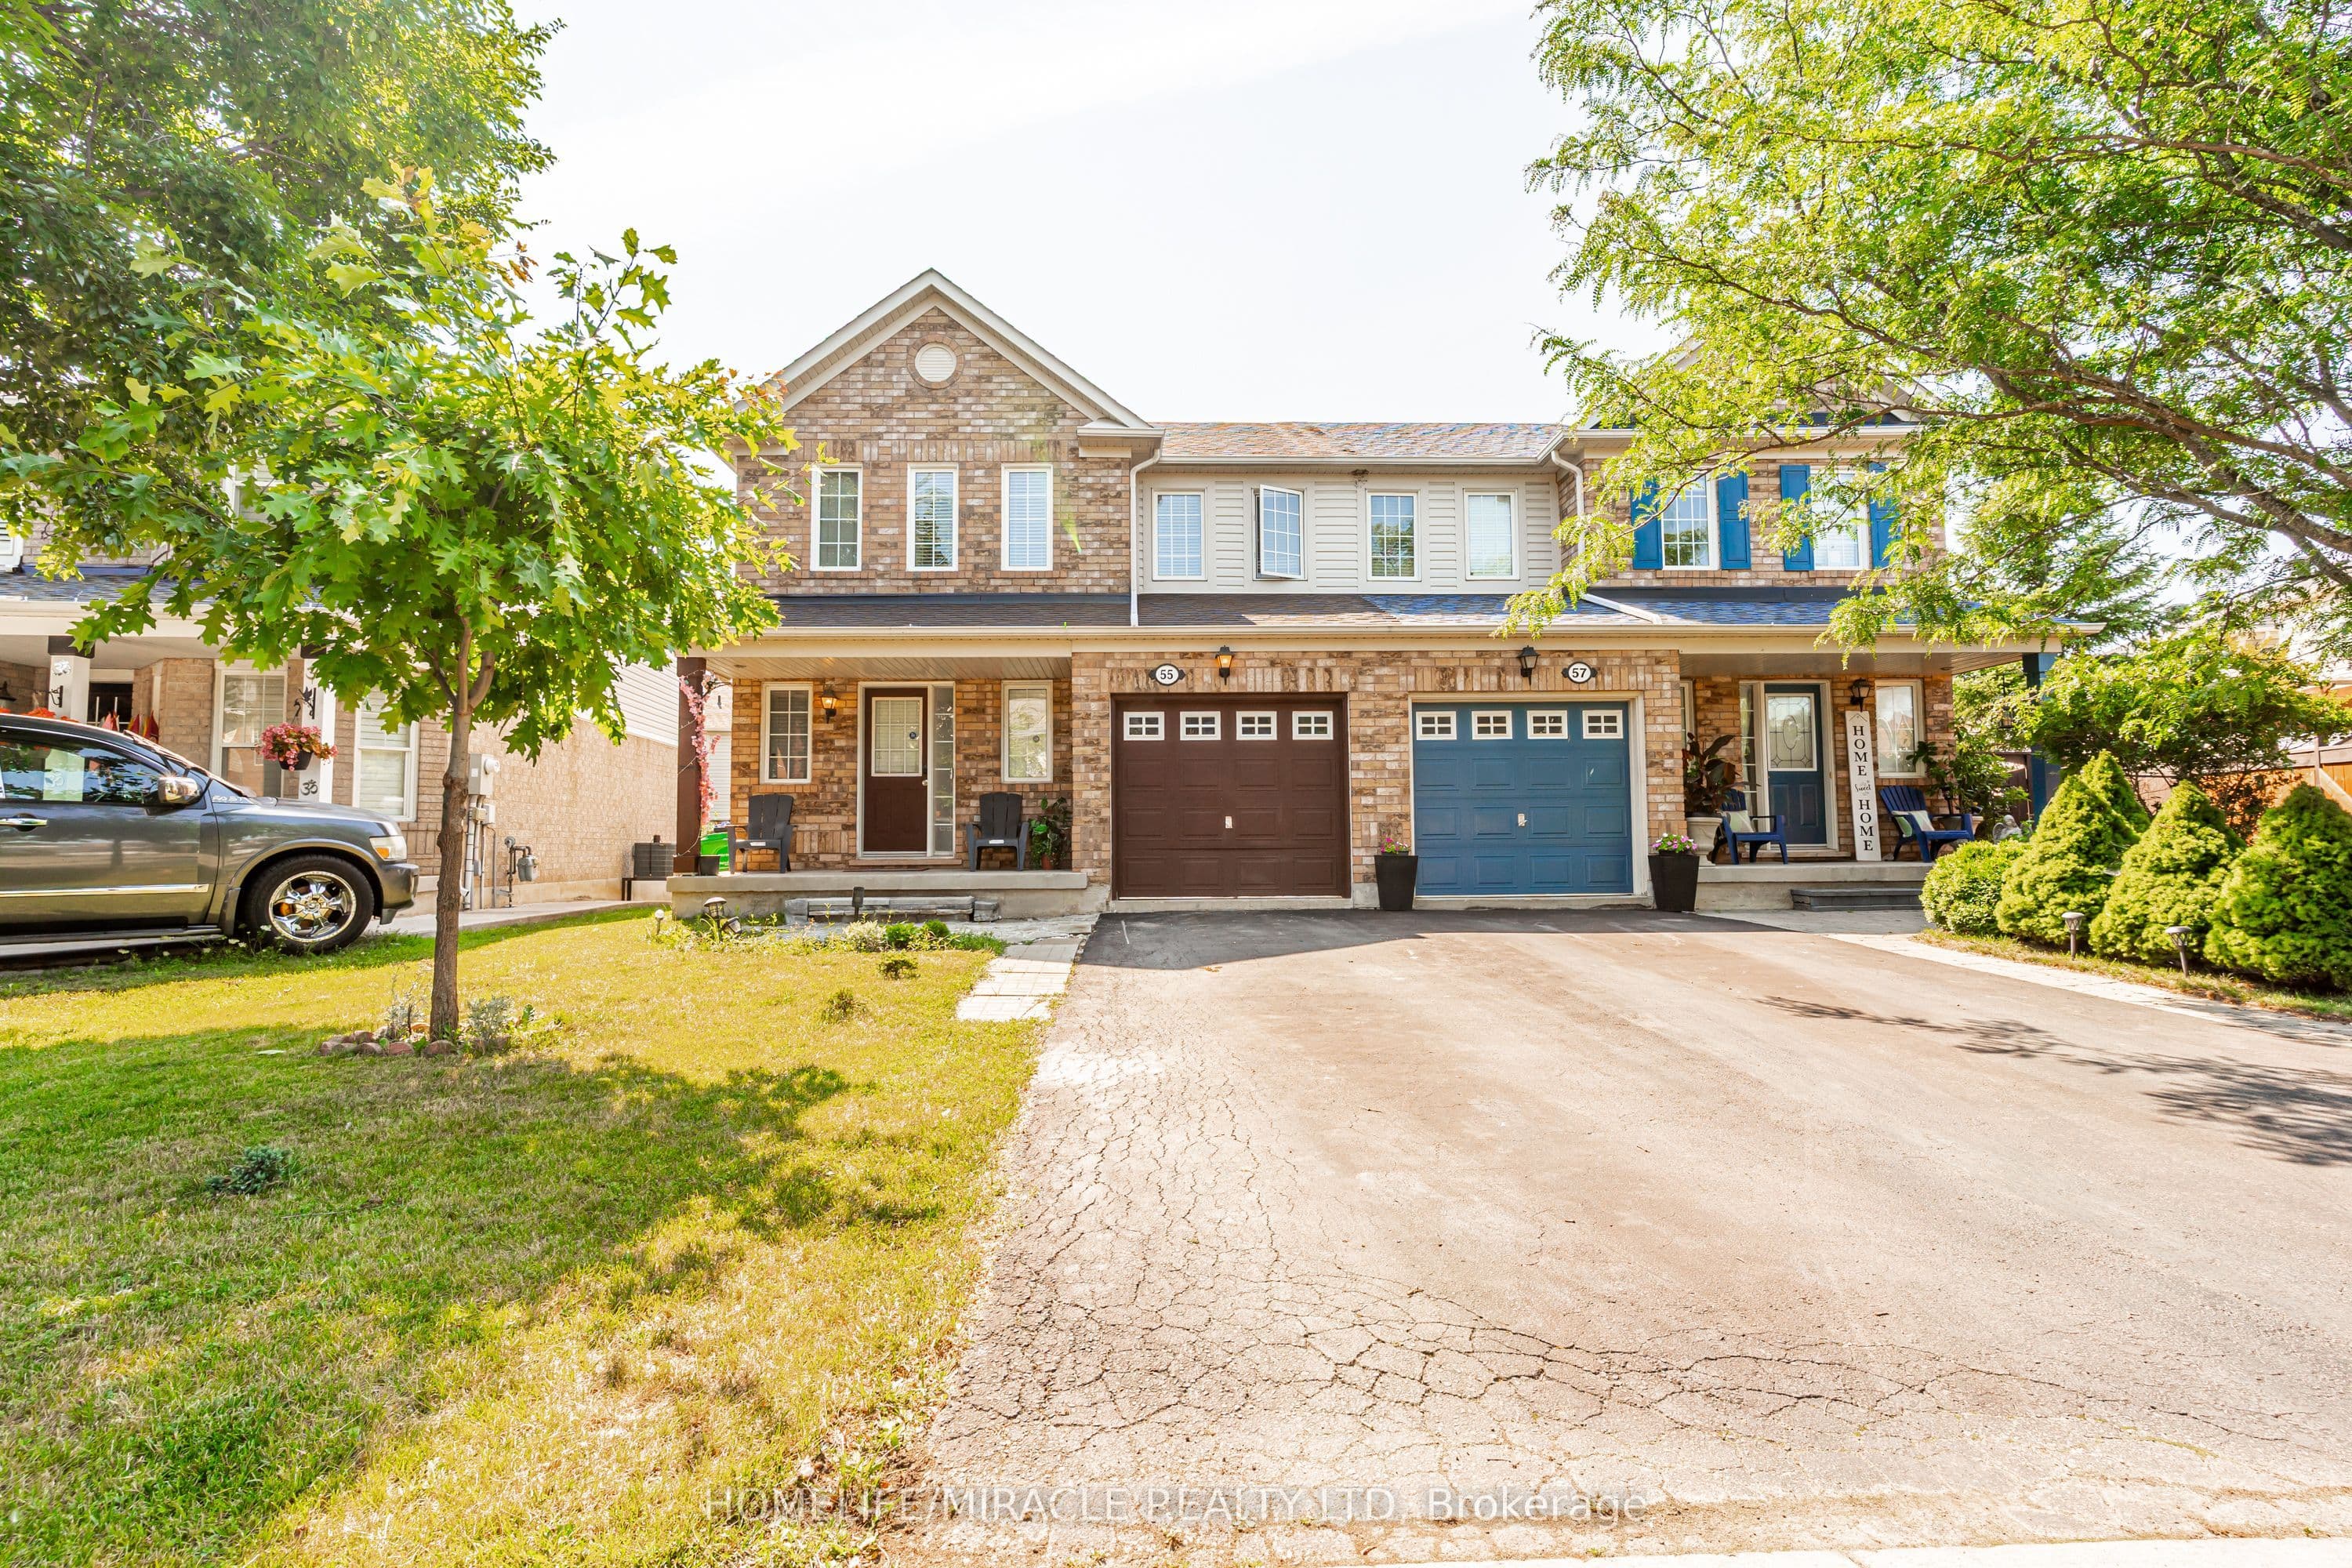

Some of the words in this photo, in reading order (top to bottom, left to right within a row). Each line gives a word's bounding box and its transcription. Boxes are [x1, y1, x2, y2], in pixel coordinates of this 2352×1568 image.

[1160, 669, 1174, 680] 55
[1572, 667, 1588, 678] 57
[1853, 725, 1868, 776] HOME
[1854, 783, 1871, 793] Sweet
[1859, 799, 1874, 851] HOME
